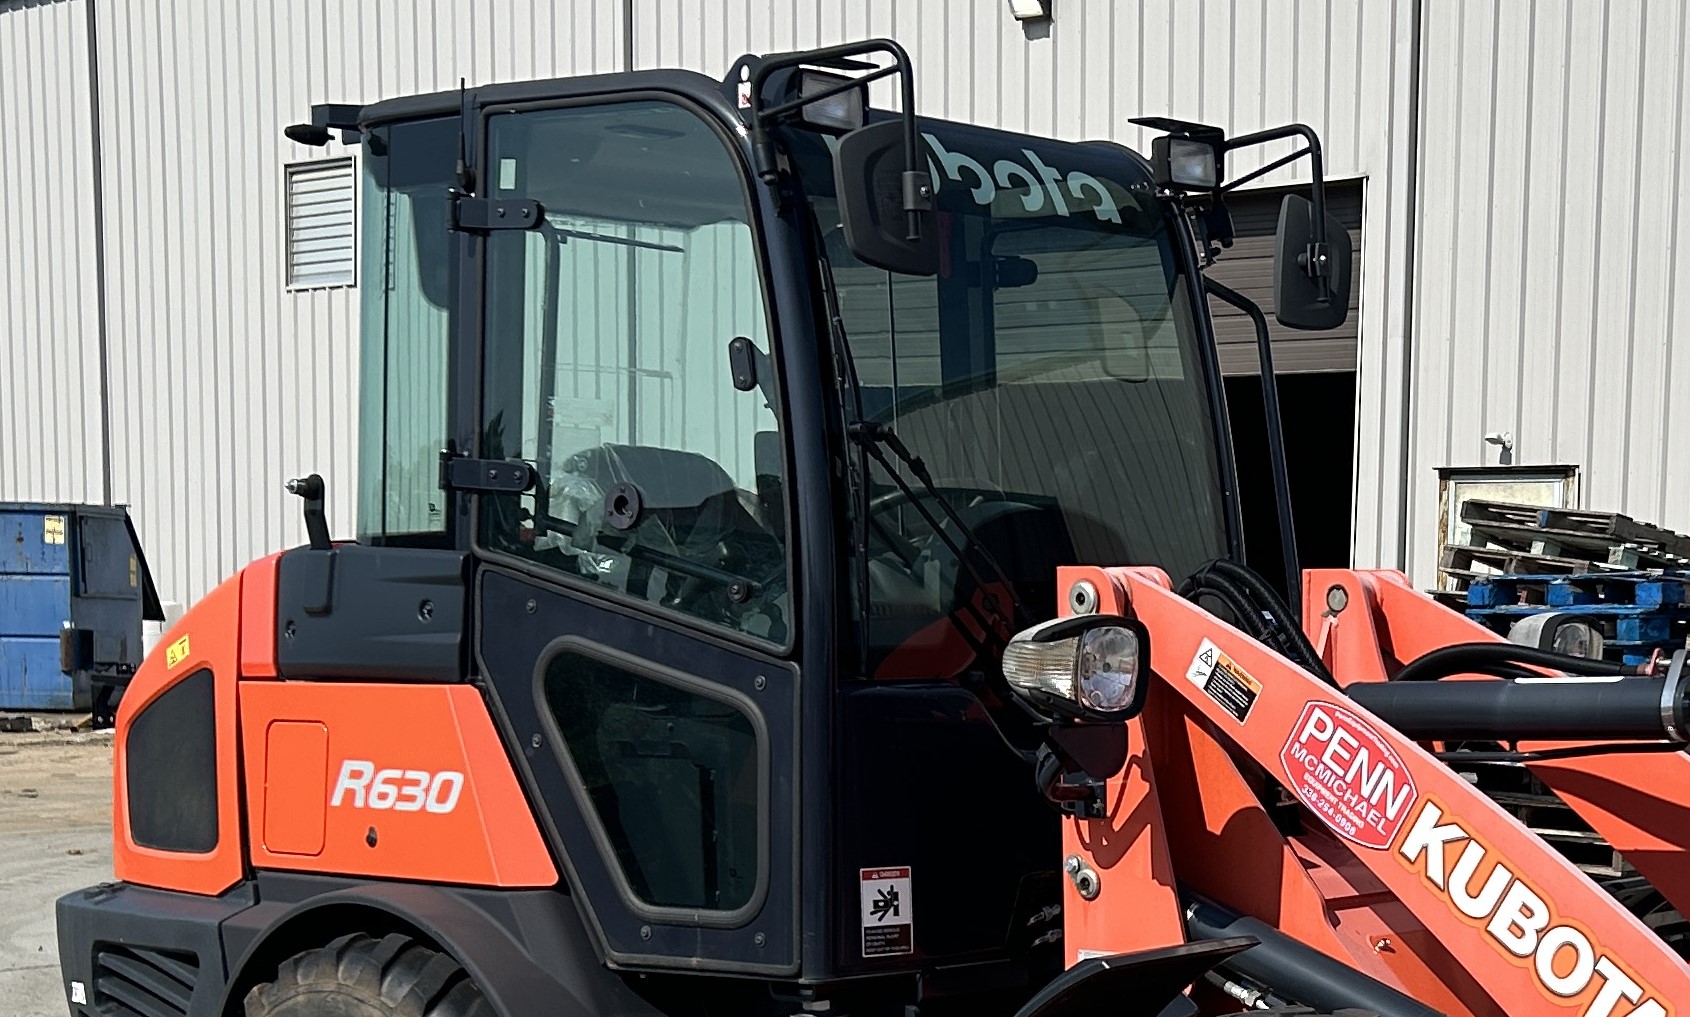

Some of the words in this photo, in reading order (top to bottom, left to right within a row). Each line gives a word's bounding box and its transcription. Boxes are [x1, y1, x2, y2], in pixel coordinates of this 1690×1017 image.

[821, 132, 1122, 224] bota
[330, 759, 465, 814] R630
[1290, 741, 1387, 836] MCMICHAEL
[1298, 706, 1411, 822] PENN
